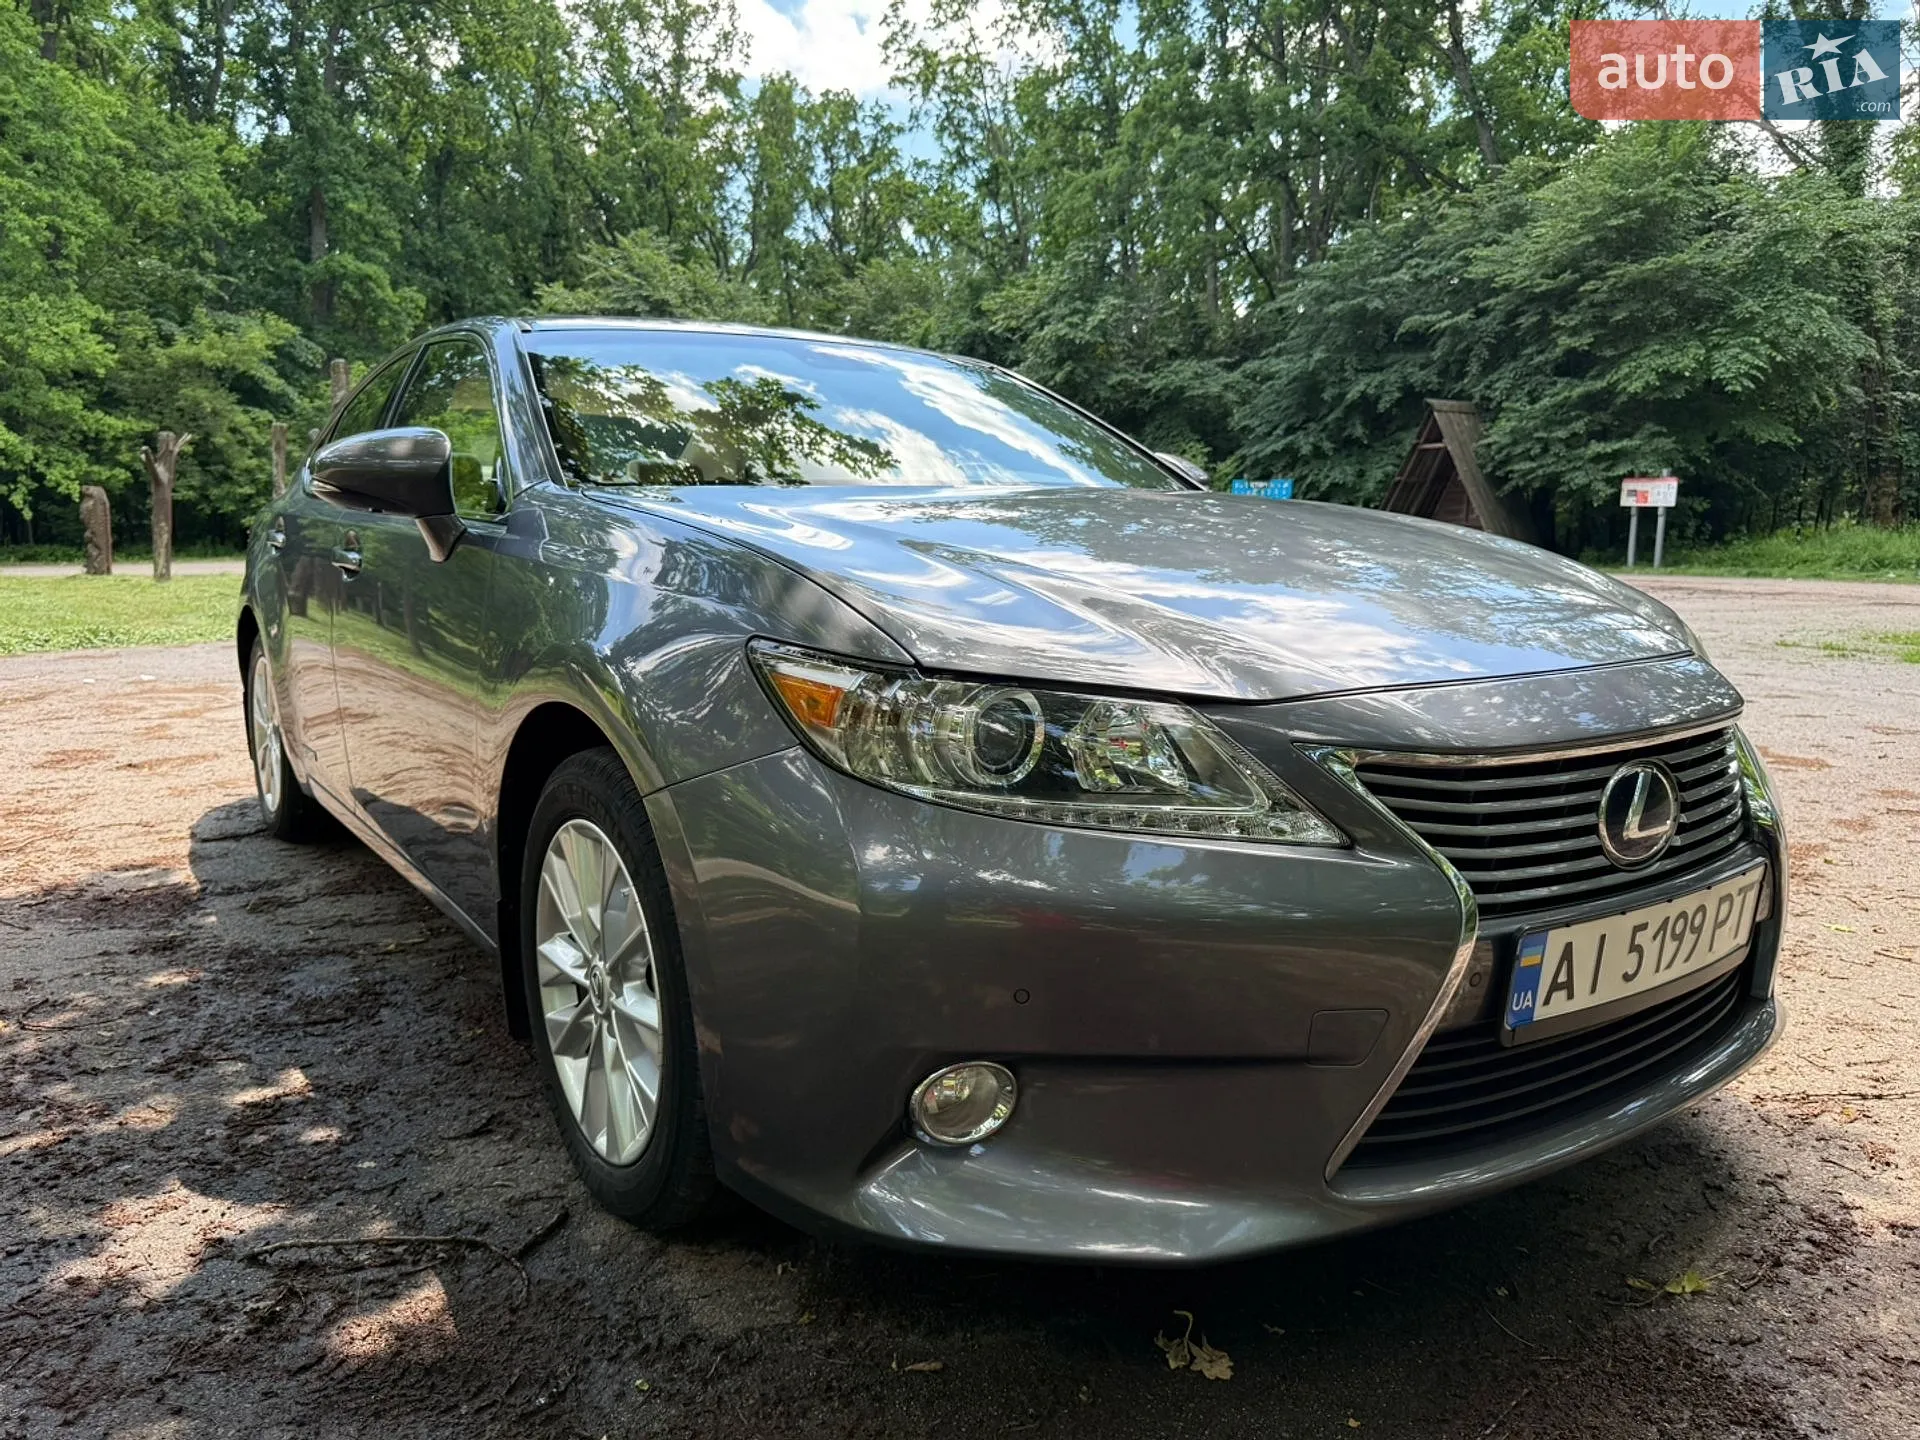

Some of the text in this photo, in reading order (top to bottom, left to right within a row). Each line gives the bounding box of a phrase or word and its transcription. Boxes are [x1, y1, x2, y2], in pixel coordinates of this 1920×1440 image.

[1542, 882, 1758, 1007] AI 5199 PT
[1512, 989, 1532, 1011] UA
